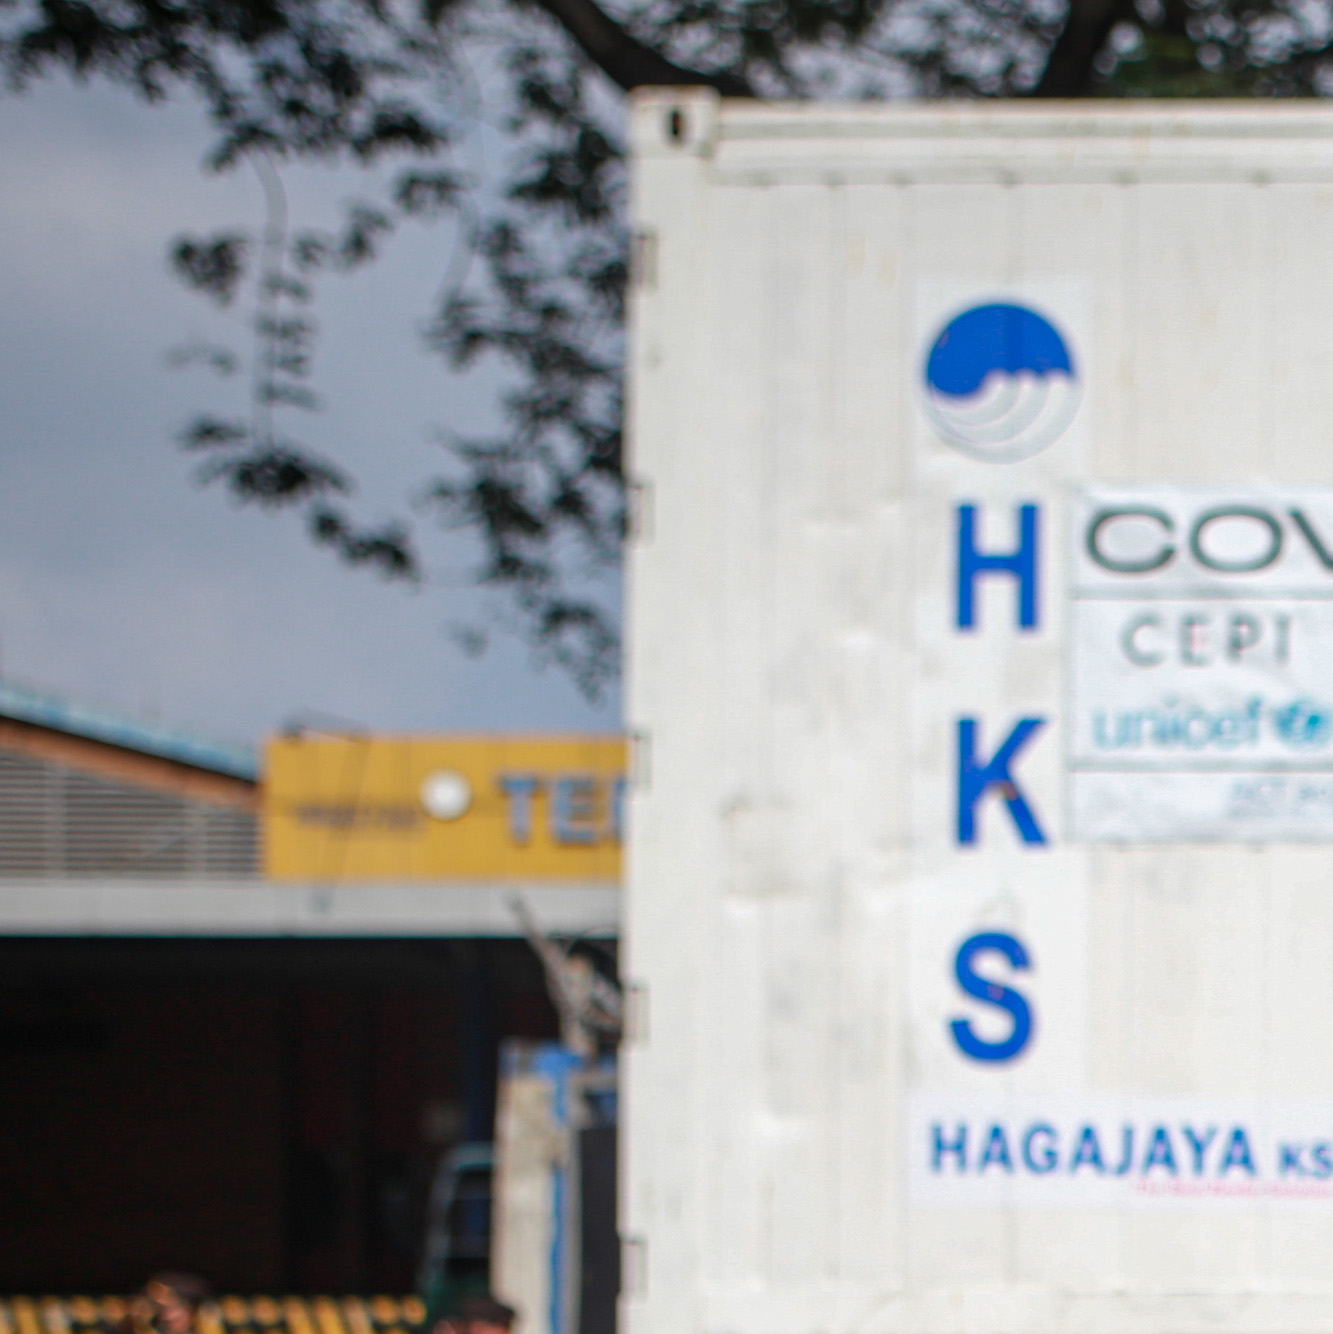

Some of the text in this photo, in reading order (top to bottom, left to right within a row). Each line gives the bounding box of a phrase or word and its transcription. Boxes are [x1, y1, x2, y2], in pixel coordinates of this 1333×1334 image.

[1119, 611, 1293, 668] CEPI
[1091, 697, 1264, 751] unicef
[498, 772, 627, 847] TE
[929, 1120, 1257, 1177] HAGAJAYA
